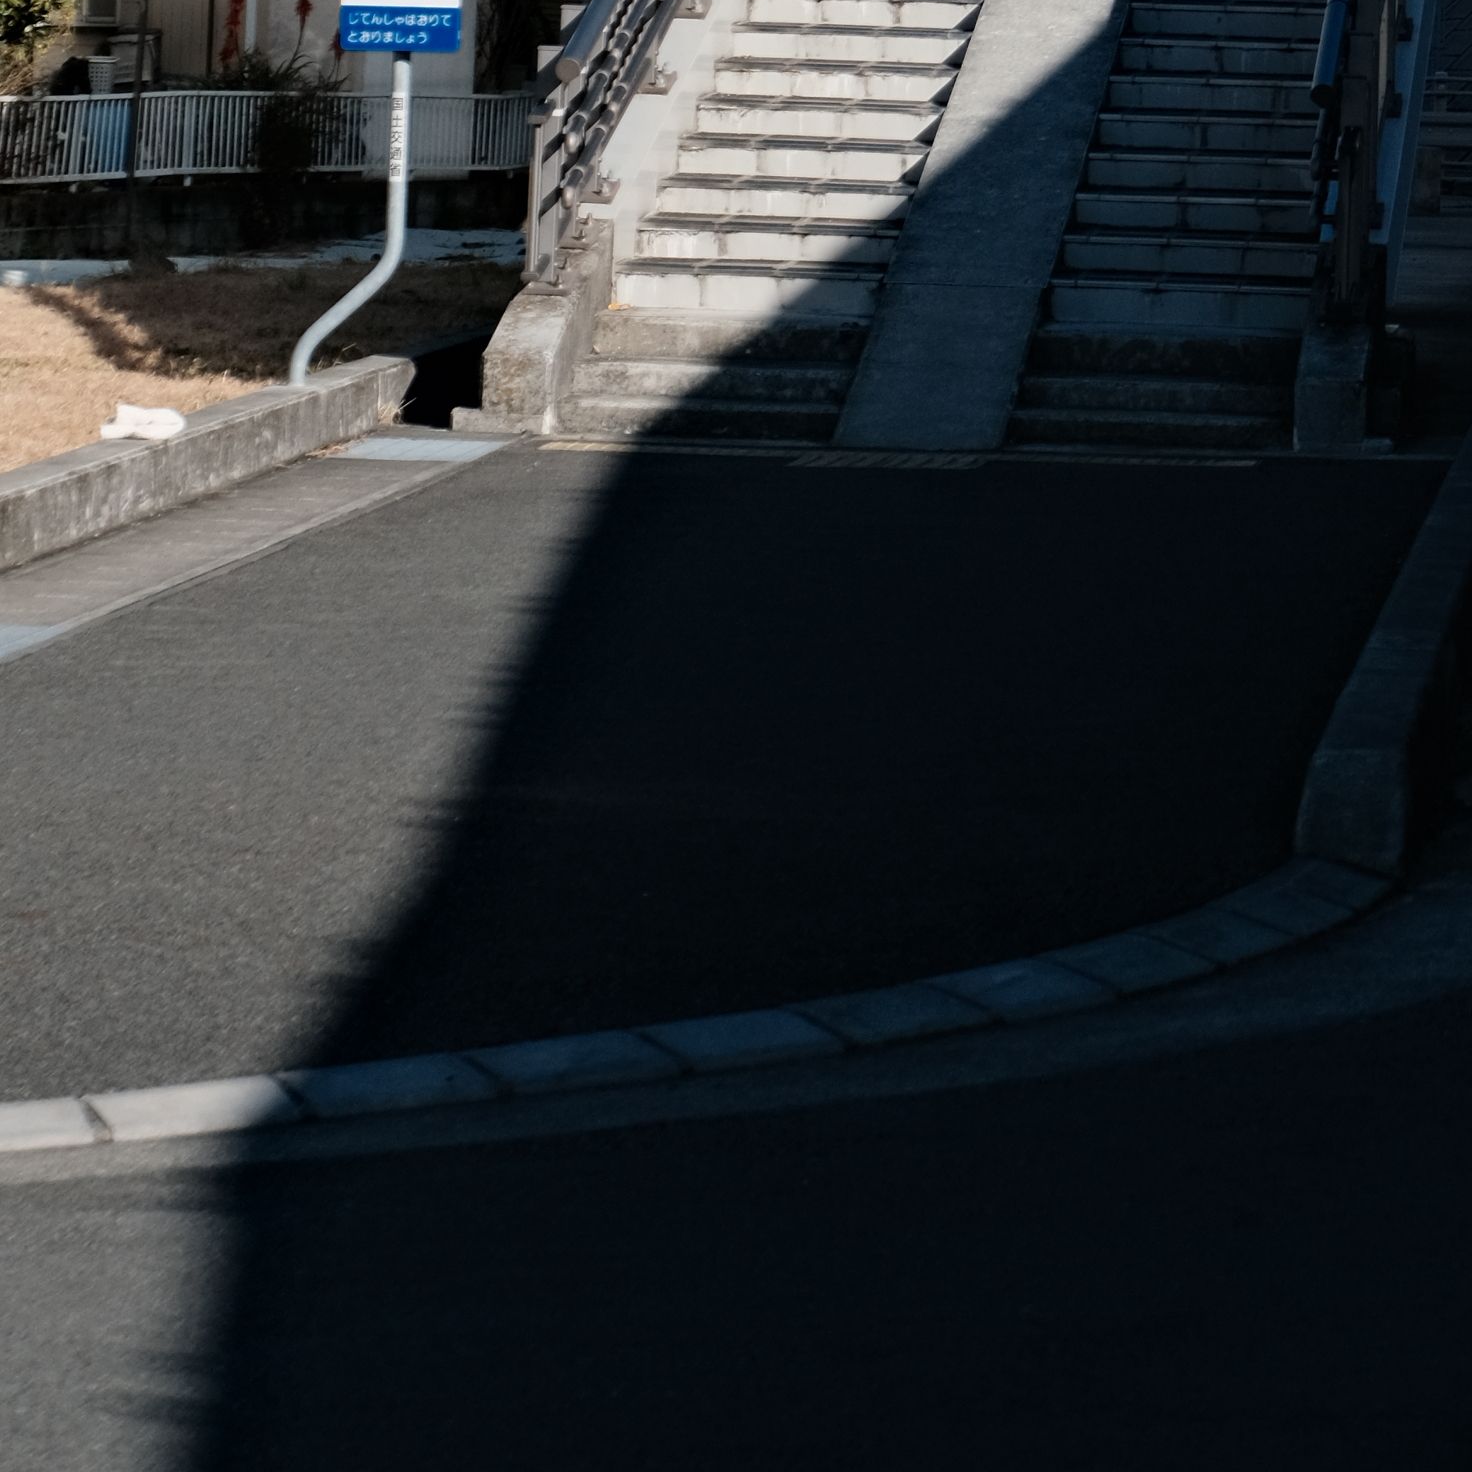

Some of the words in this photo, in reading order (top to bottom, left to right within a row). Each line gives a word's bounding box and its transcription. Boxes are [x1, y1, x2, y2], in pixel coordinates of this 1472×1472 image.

[348, 12, 452, 27] じてんしゃはおりて
[347, 30, 428, 44] とおりましょう
[390, 97, 403, 177] 国土交通省
